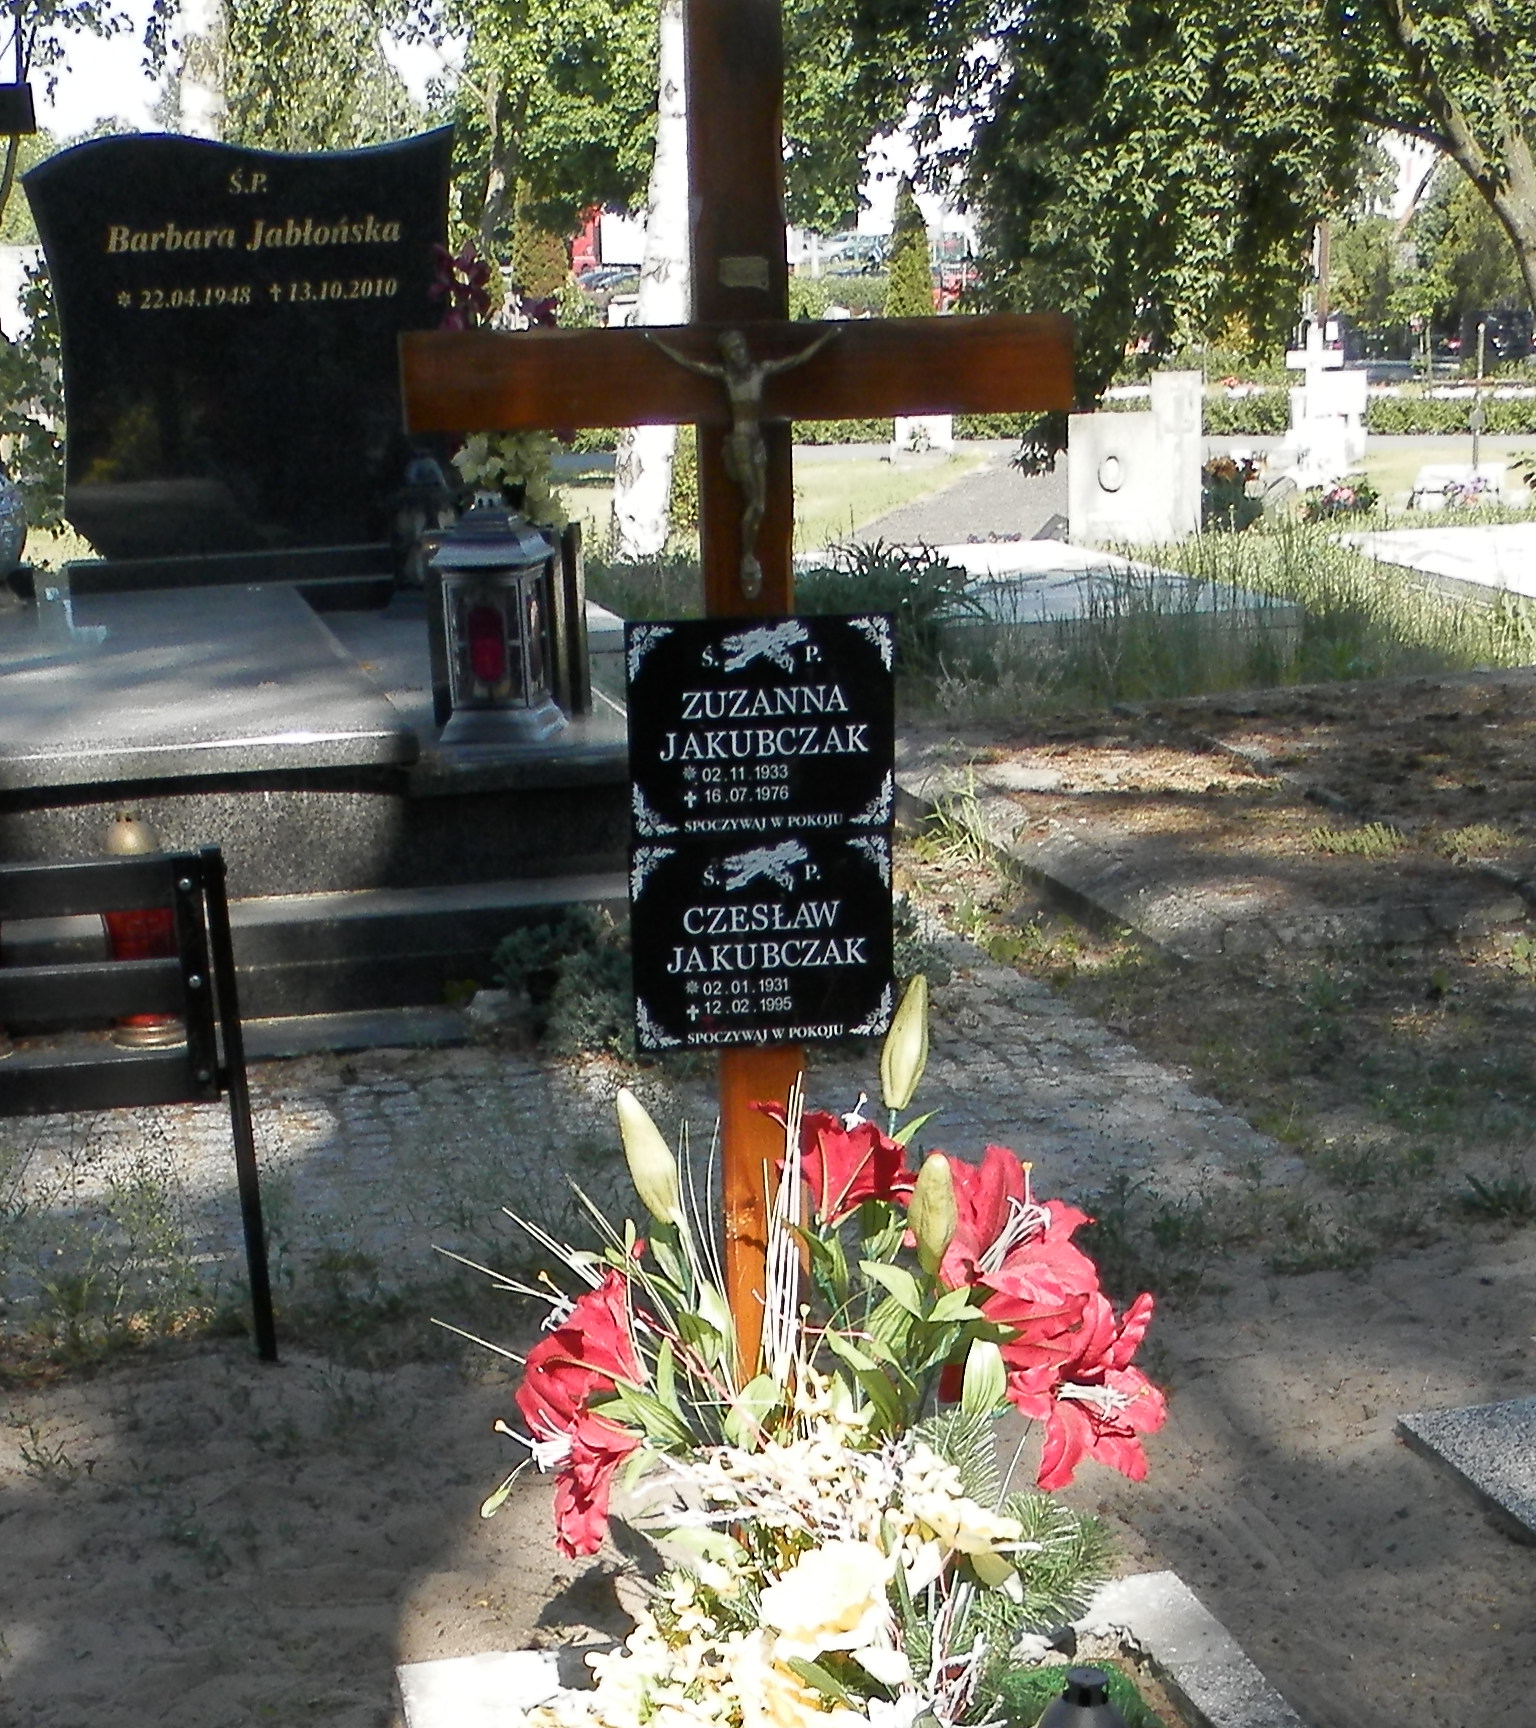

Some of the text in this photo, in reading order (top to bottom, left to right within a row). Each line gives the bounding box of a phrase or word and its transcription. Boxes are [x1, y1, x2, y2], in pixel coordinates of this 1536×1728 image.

[106, 214, 401, 254] Barbara Jabłońska
[289, 279, 398, 303] 13.10.2010
[805, 645, 823, 663] P.
[681, 684, 849, 720] ZUZANNA
[659, 724, 869, 762] JAKUBCZAK
[684, 812, 844, 833] SPOCZYWAJ W POKOJU
[804, 864, 821, 881] P.
[682, 900, 840, 935] CZESŁAW
[666, 937, 867, 974] JAKUBCZAK
[687, 1024, 844, 1045] SPOCZYWAJ W POKOJU
